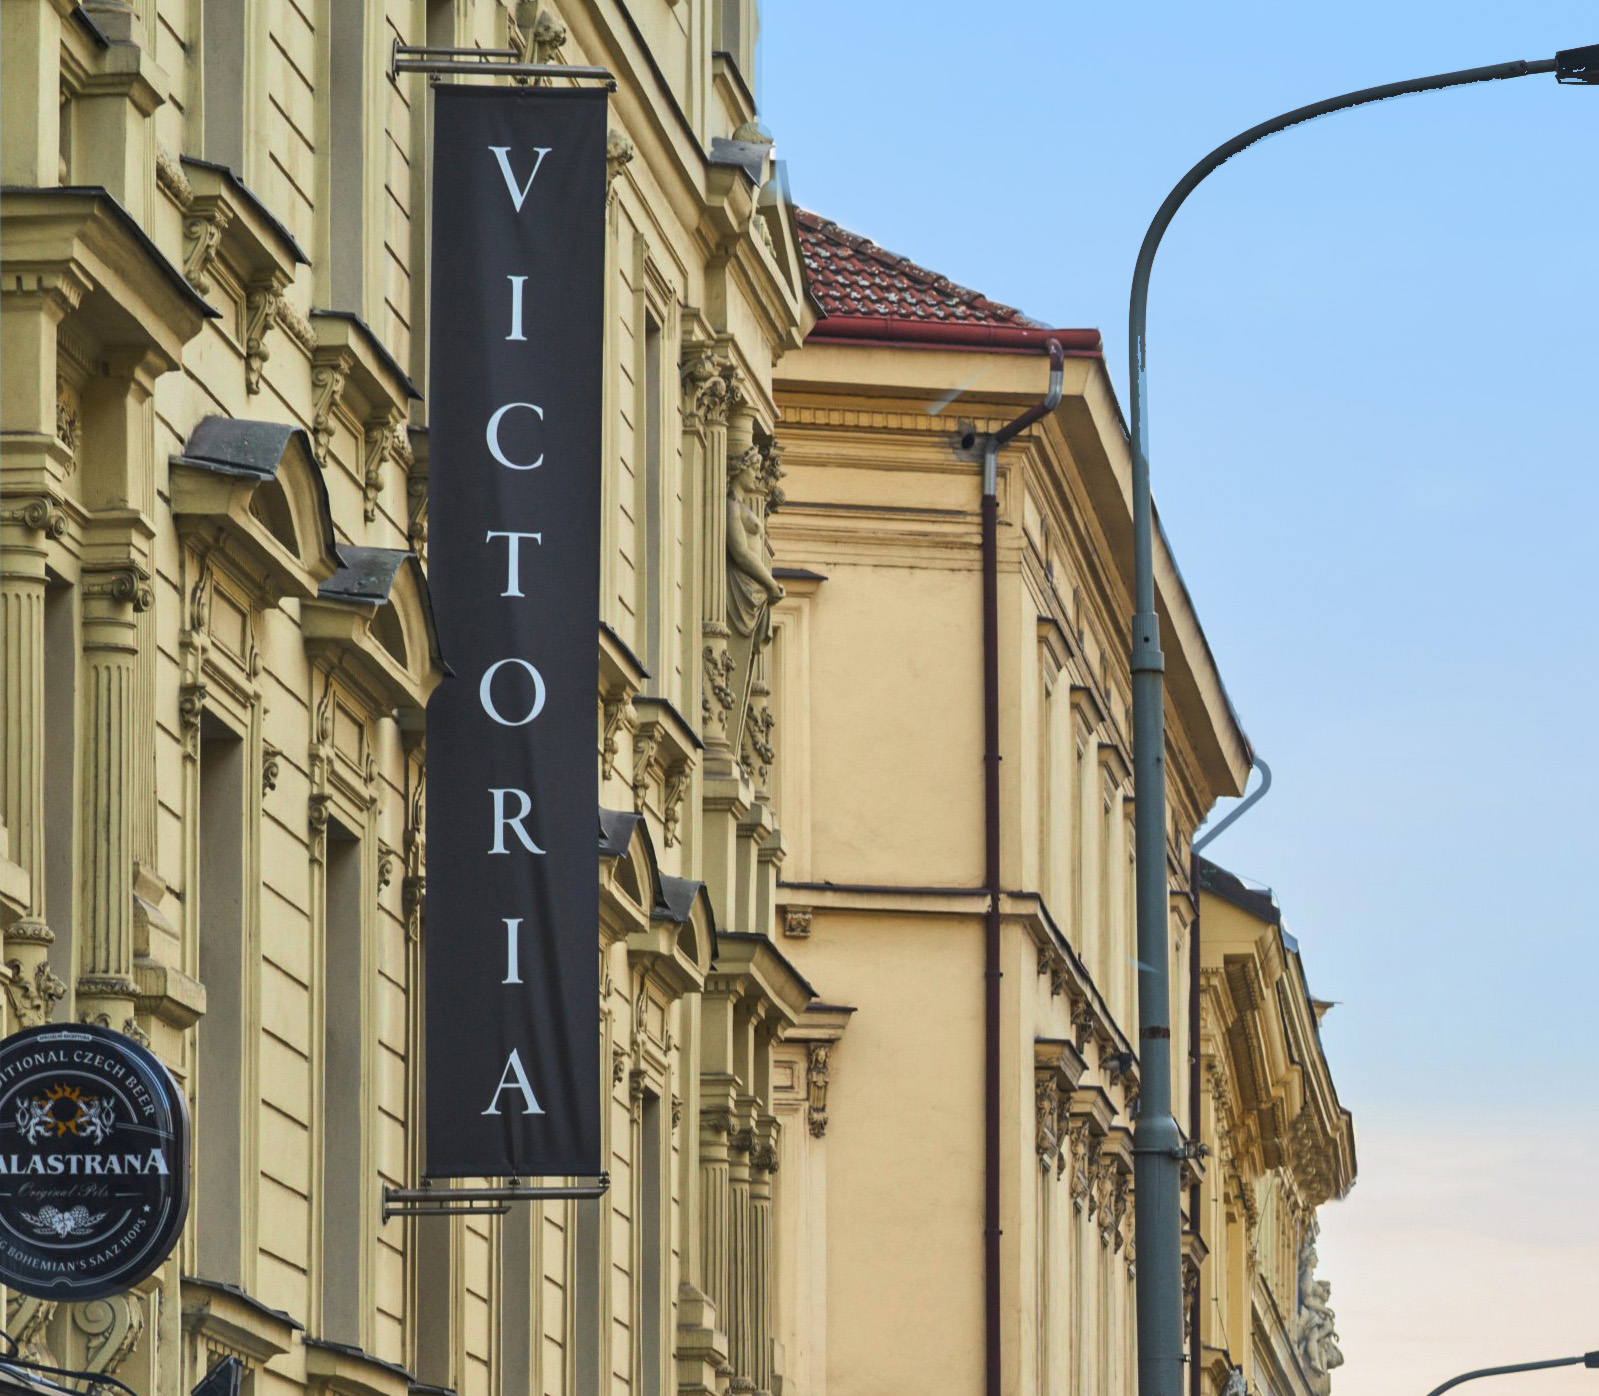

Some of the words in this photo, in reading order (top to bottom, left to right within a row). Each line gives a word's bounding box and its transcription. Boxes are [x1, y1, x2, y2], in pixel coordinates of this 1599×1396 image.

[478, 144, 548, 1116] VICTORIA
[0, 1050, 68, 1088] ITIONAL
[73, 1050, 126, 1079] CZECH
[124, 1076, 156, 1117] BEER
[18, 1181, 78, 1199] Original
[7, 1246, 87, 1272] BOHEMIAN'S
[89, 1244, 122, 1268] SAAZ
[120, 1217, 148, 1248] HOPS
